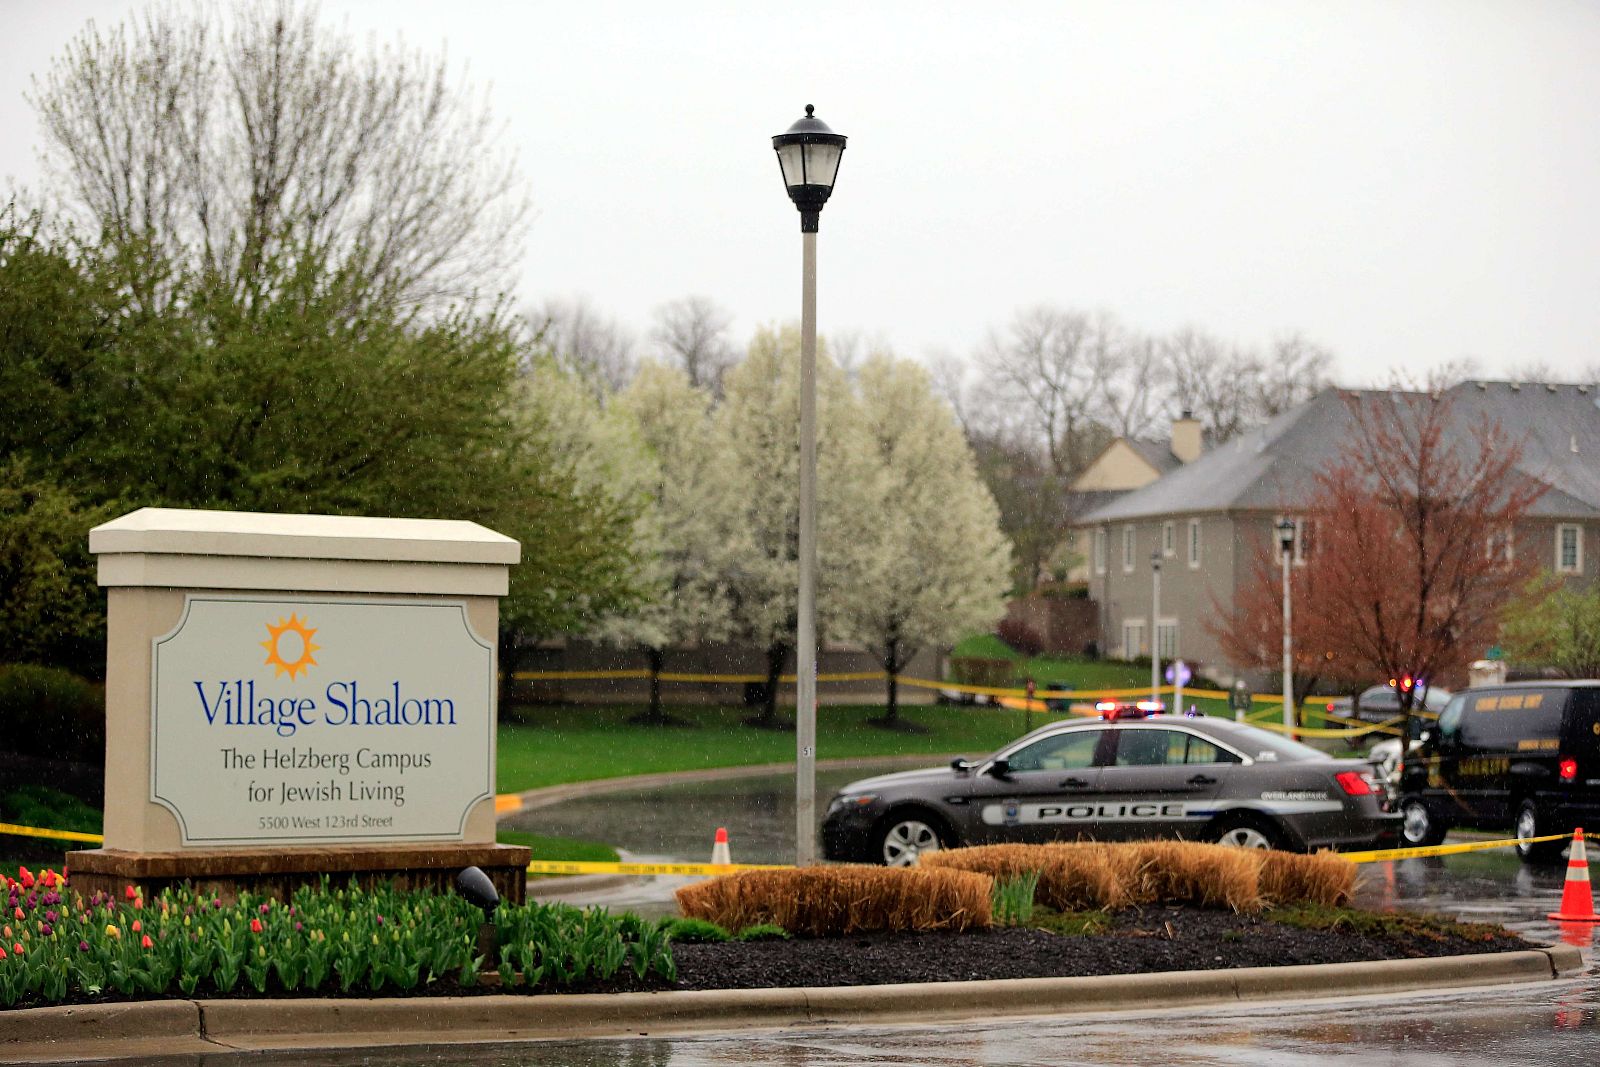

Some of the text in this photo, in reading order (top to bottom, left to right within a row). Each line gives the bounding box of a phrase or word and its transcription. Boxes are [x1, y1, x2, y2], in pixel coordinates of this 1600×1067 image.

[193, 680, 457, 738] Village Shalom
[221, 747, 432, 776] The Helzberg Campus
[248, 779, 406, 807] for Jewish Living
[259, 814, 393, 830] 5500 West 123rd Street
[1037, 803, 1185, 819] POLICE
